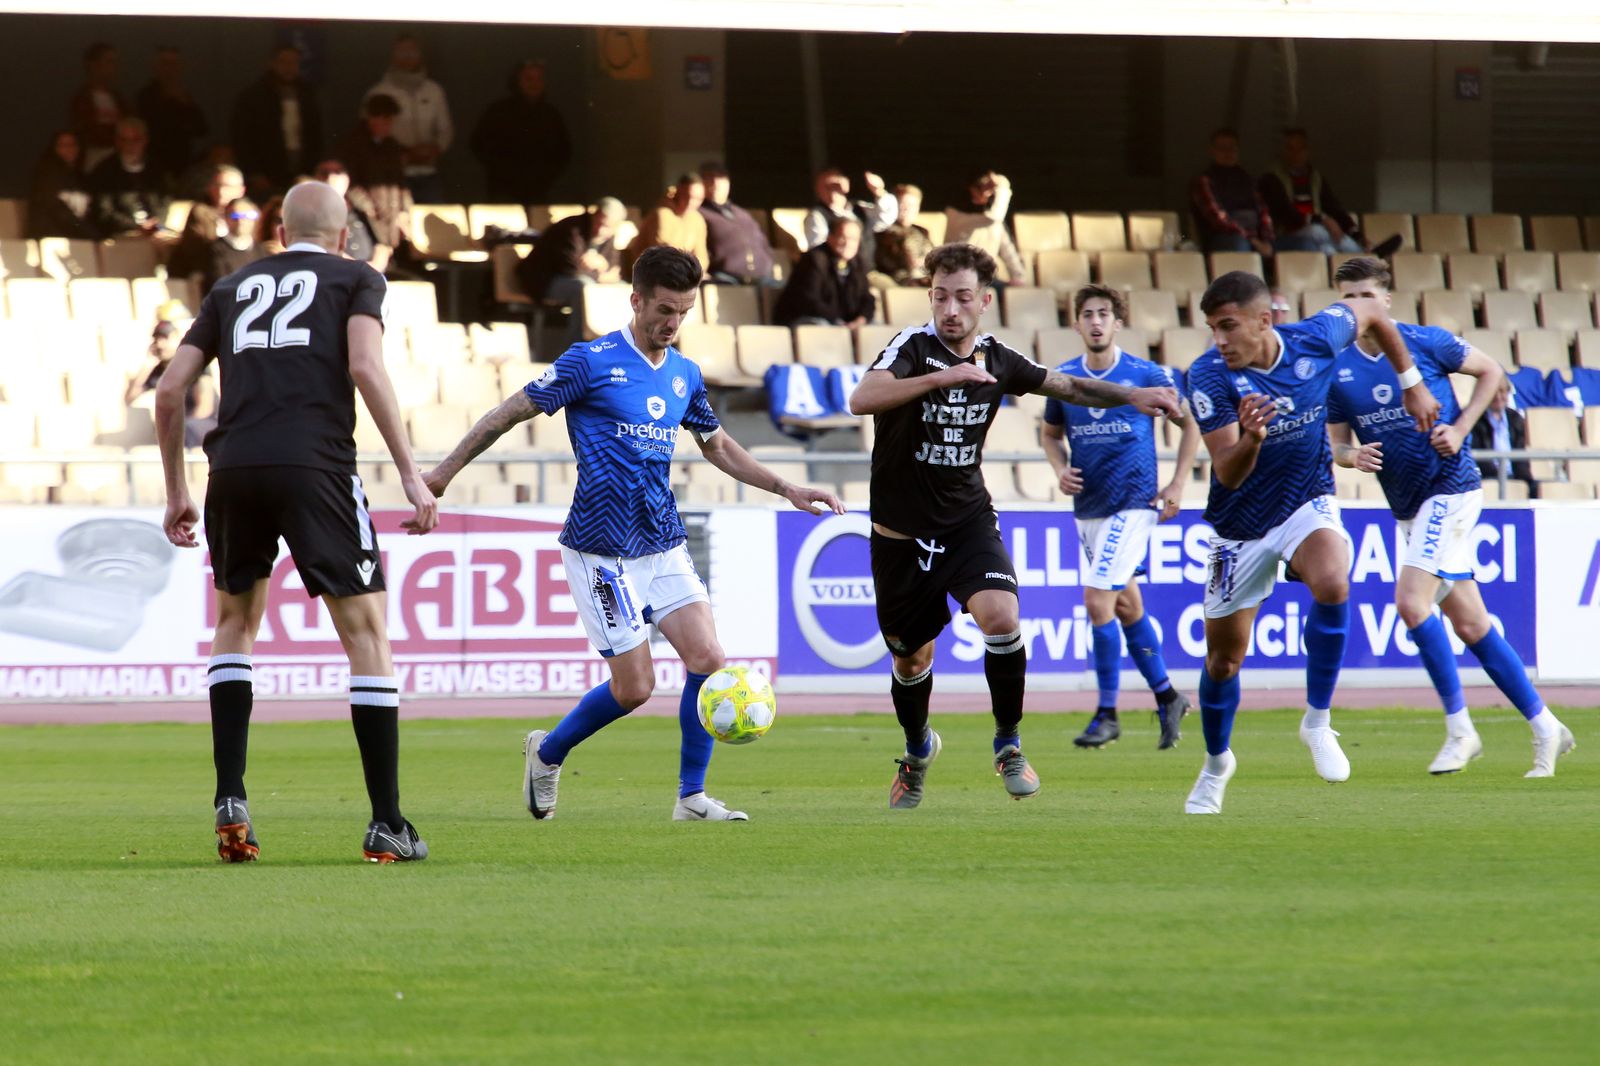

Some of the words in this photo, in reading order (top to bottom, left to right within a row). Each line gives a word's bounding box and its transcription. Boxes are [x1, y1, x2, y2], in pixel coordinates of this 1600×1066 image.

[233, 270, 318, 354] 22
[926, 357, 950, 370] macr
[948, 389, 967, 403] EL
[922, 403, 991, 425] XEREZ
[1357, 406, 1408, 428] prefor
[943, 428, 964, 443] DE
[632, 440, 672, 455] academi
[915, 442, 977, 467] JEREZ
[811, 585, 875, 599] VOLV
[415, 662, 543, 692] ENVASES
[548, 662, 586, 691] DE
